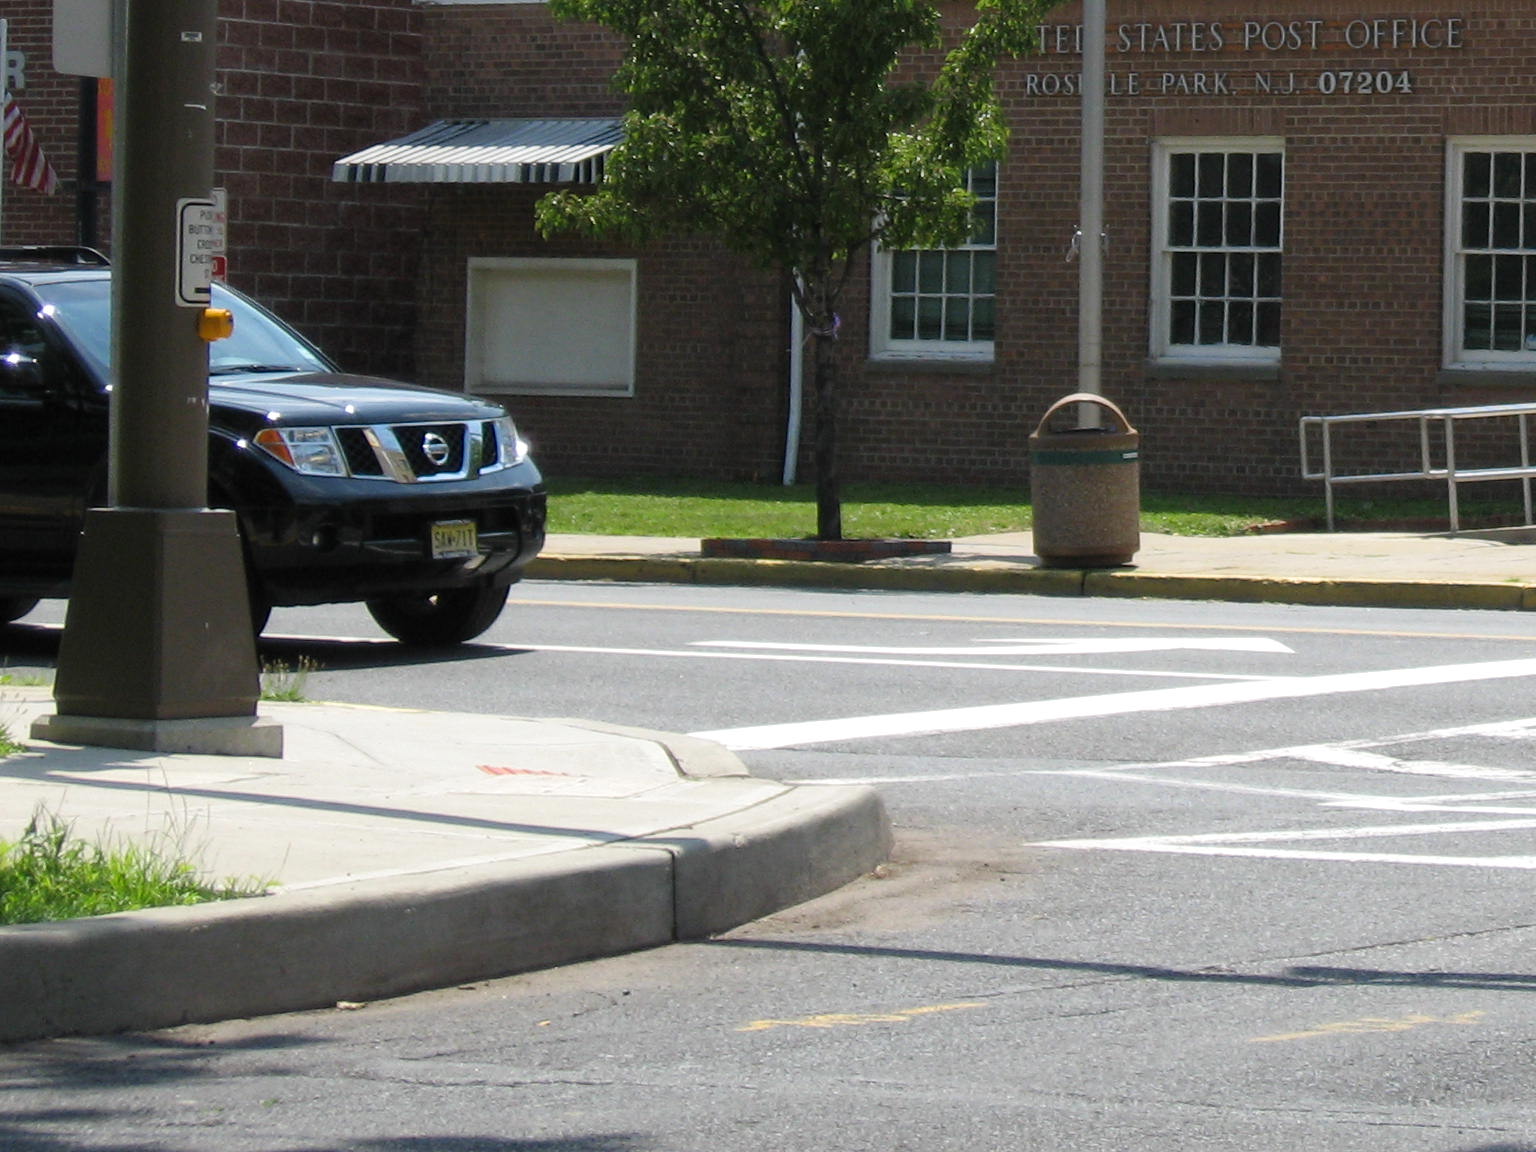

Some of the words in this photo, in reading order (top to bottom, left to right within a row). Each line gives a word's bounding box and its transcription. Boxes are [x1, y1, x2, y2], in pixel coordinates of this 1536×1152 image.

[1116, 22, 1224, 53] STATES
[1244, 20, 1323, 51] POST
[1344, 18, 1463, 49] OFFICE
[1026, 73, 1140, 96] ROSLE
[1318, 70, 1412, 94] 07204
